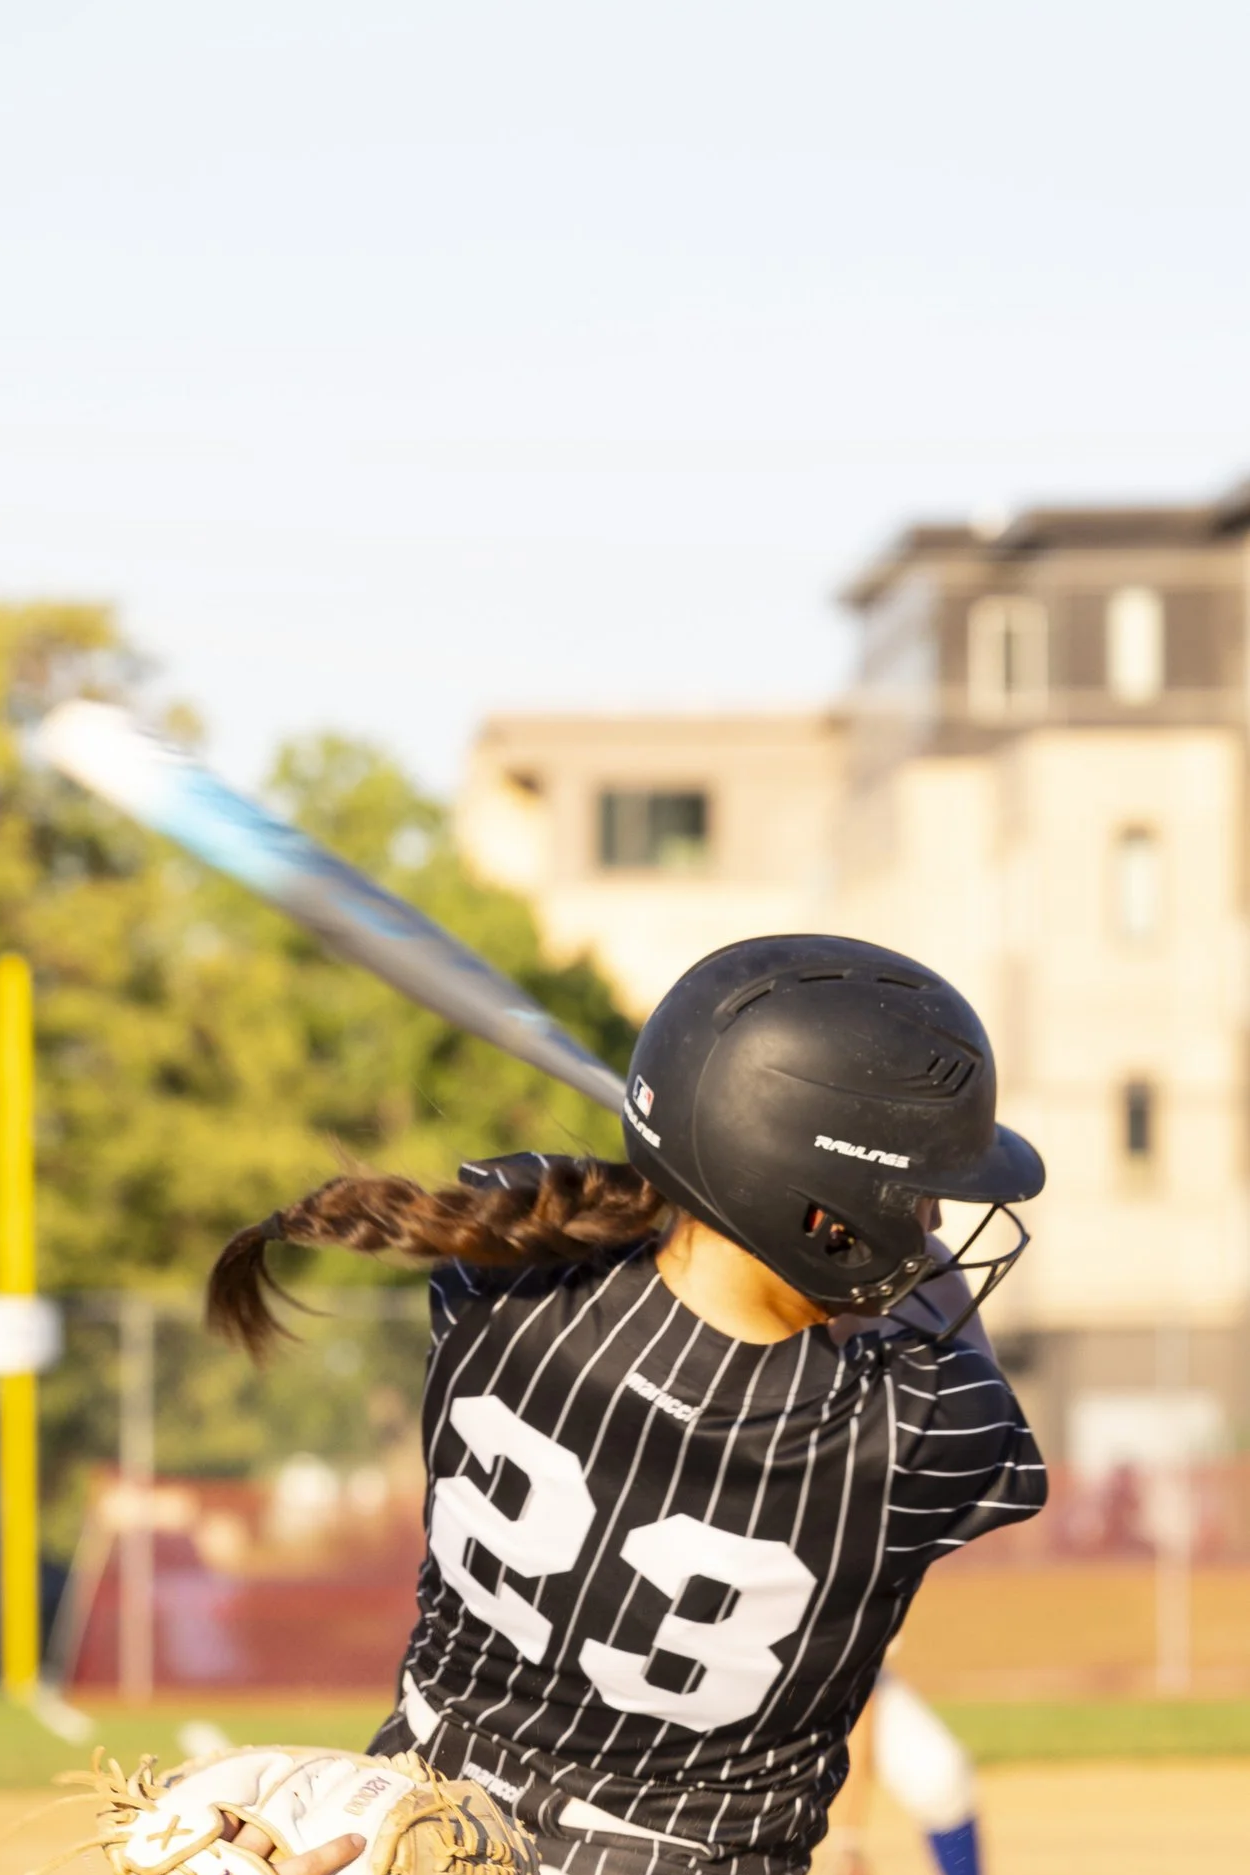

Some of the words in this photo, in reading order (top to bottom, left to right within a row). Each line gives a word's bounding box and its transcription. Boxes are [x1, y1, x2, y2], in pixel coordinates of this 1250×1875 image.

[814, 1135, 910, 1169] RAWLINGS
[627, 1372, 702, 1422] marucci
[430, 1395, 817, 1732] 23
[462, 1762, 525, 1803] marucci
